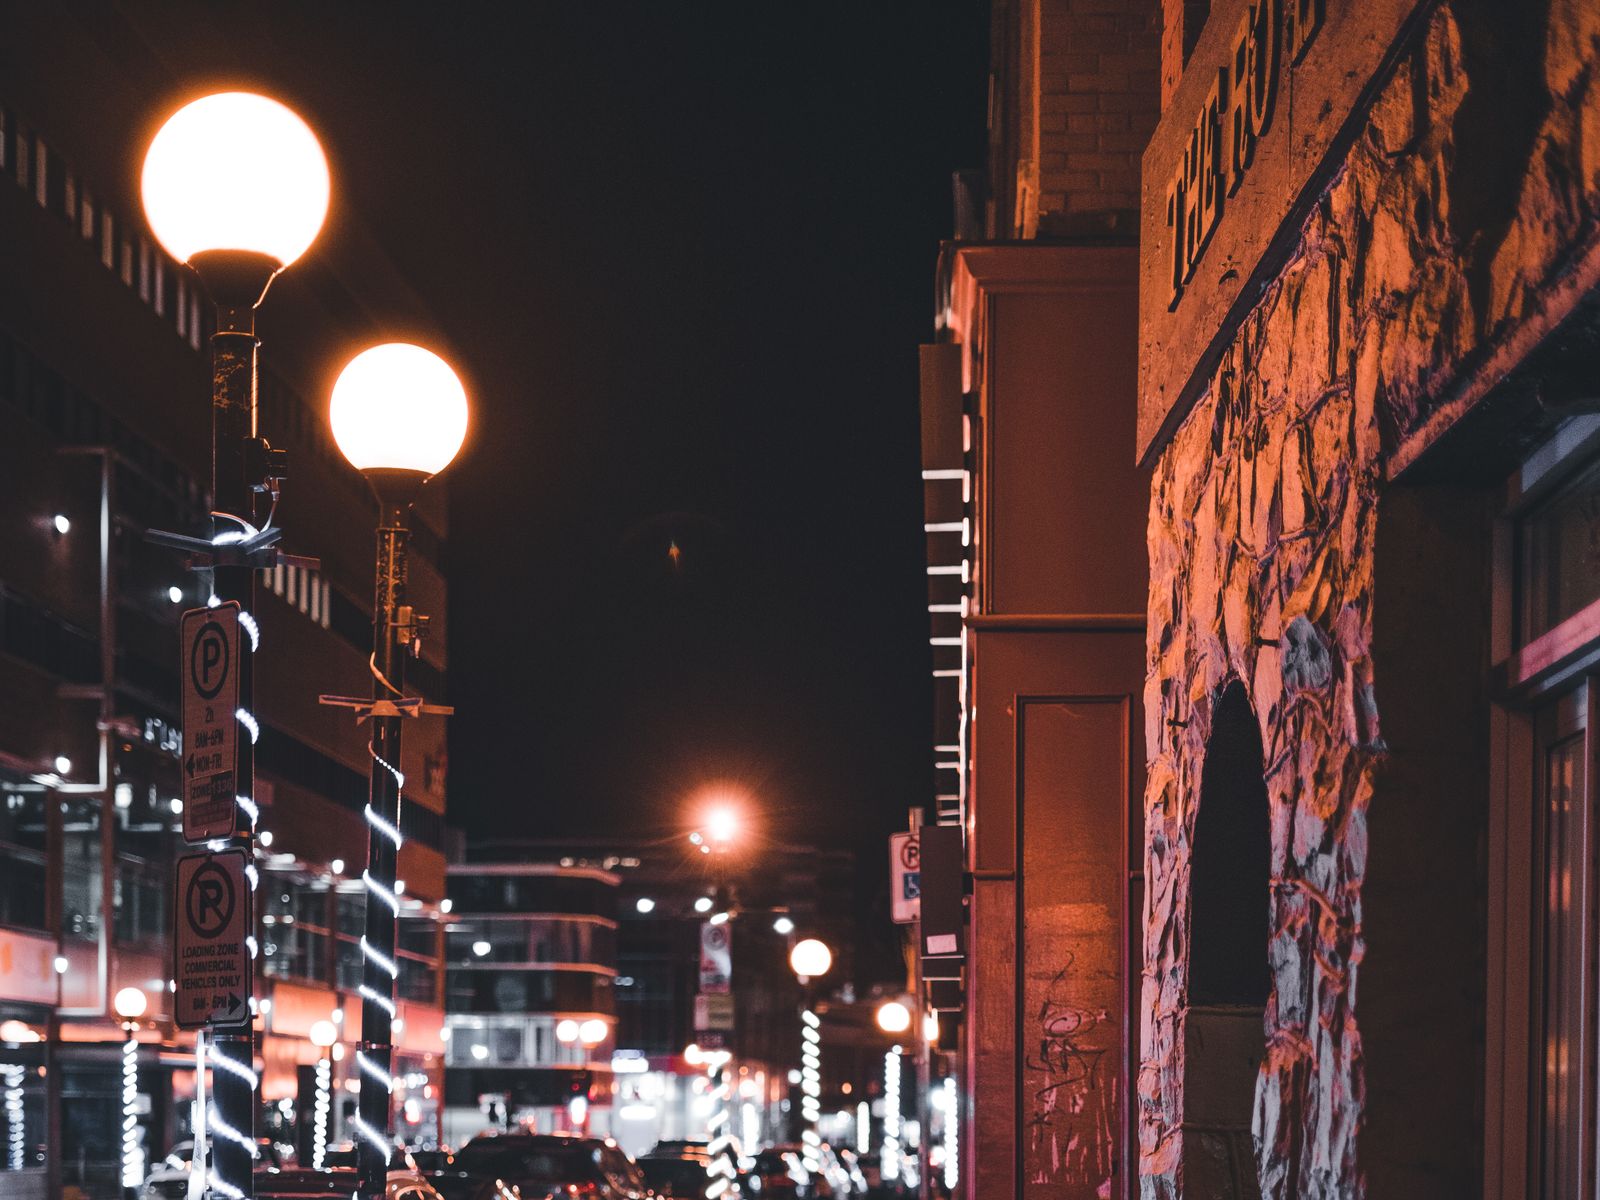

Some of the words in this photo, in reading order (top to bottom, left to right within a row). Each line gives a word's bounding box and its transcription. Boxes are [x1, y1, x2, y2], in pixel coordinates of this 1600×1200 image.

[1166, 67, 1228, 312] THE
[203, 637, 221, 684] P
[196, 752, 222, 772] MON-FRI
[182, 945, 215, 958] LOADING
[217, 943, 239, 956] ZONE
[184, 959, 236, 974] COMMERCIAL
[181, 976, 217, 990] VEHICLES
[218, 975, 241, 988] ONLY
